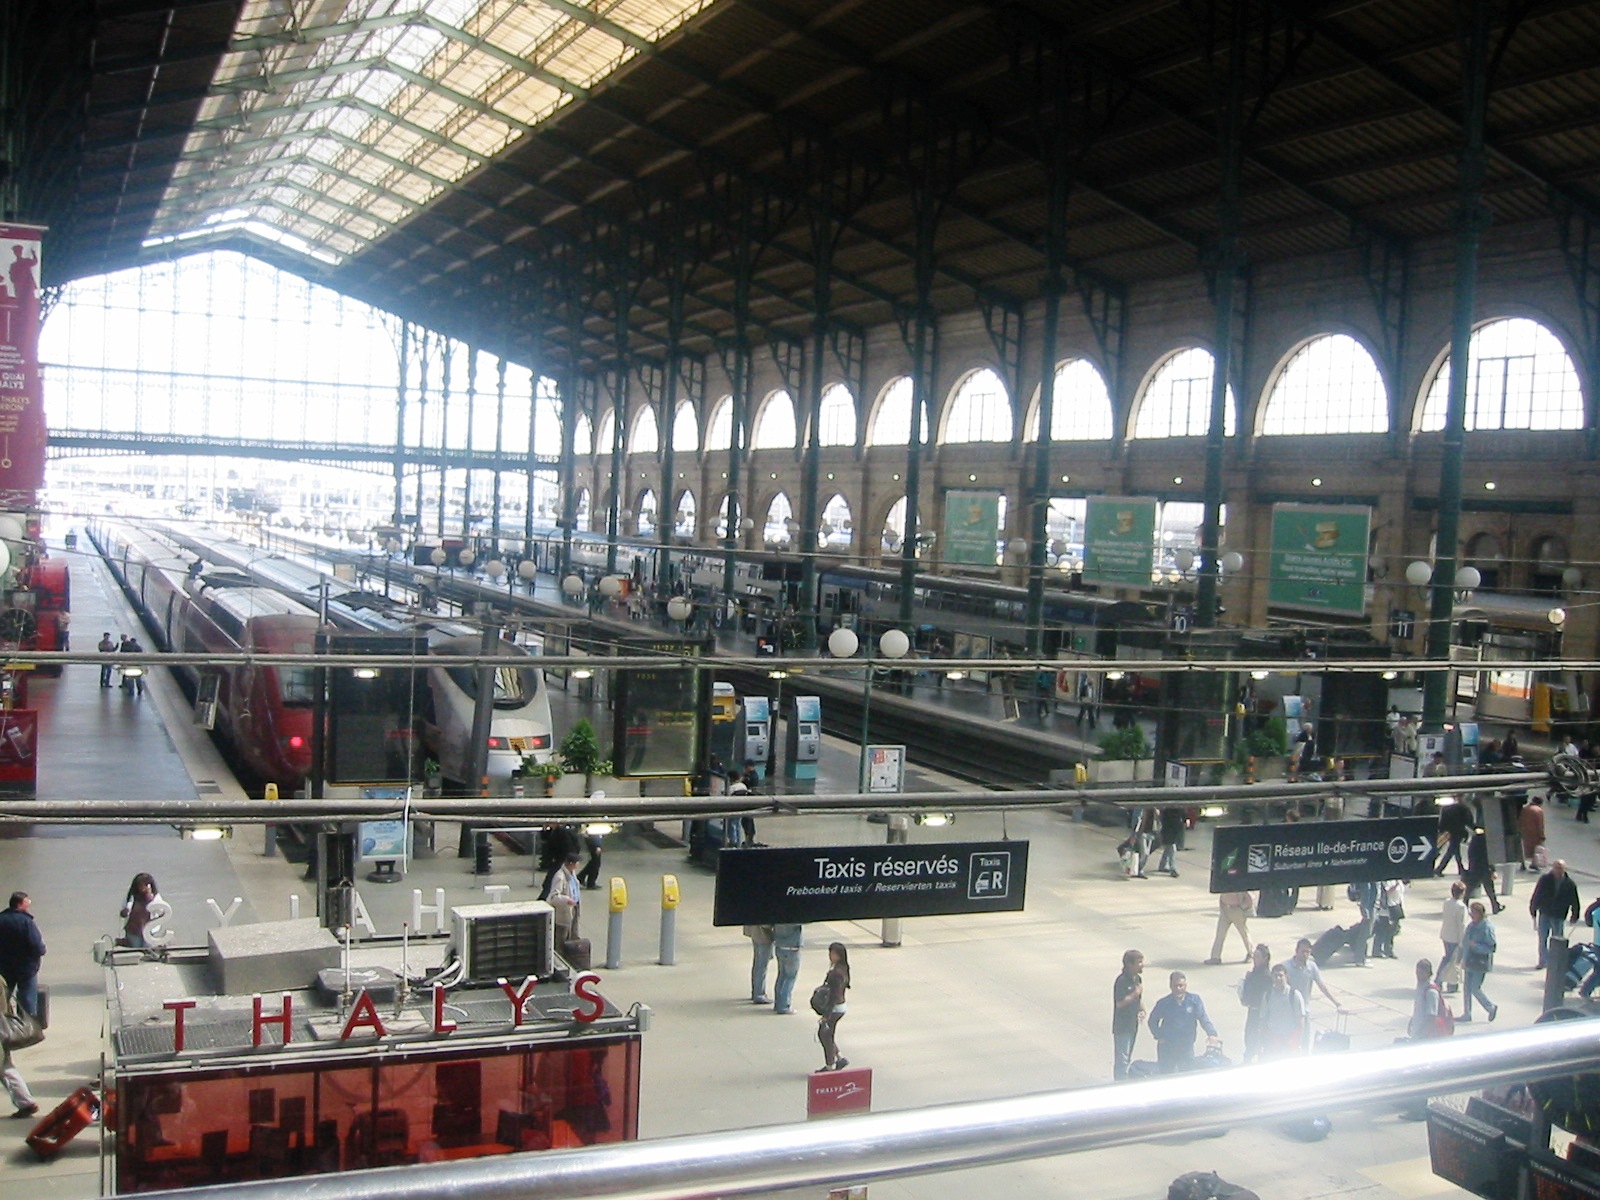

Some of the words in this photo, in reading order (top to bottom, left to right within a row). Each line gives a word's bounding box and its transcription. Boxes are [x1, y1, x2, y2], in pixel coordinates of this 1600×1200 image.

[1174, 615, 1187, 634] 10
[1398, 621, 1408, 637] 11
[1274, 843, 1314, 857] Réseau
[1317, 840, 1385, 854] Ile-de-France
[814, 857, 866, 879] Taxis
[873, 854, 959, 877] réservés
[980, 857, 1000, 867] Taxis
[786, 885, 838, 896] Prebooked
[840, 884, 863, 894] taxis
[874, 881, 933, 892] Reservierten
[935, 880, 957, 889] taxis
[992, 873, 1003, 890] R
[163, 972, 605, 1051] THALYS
